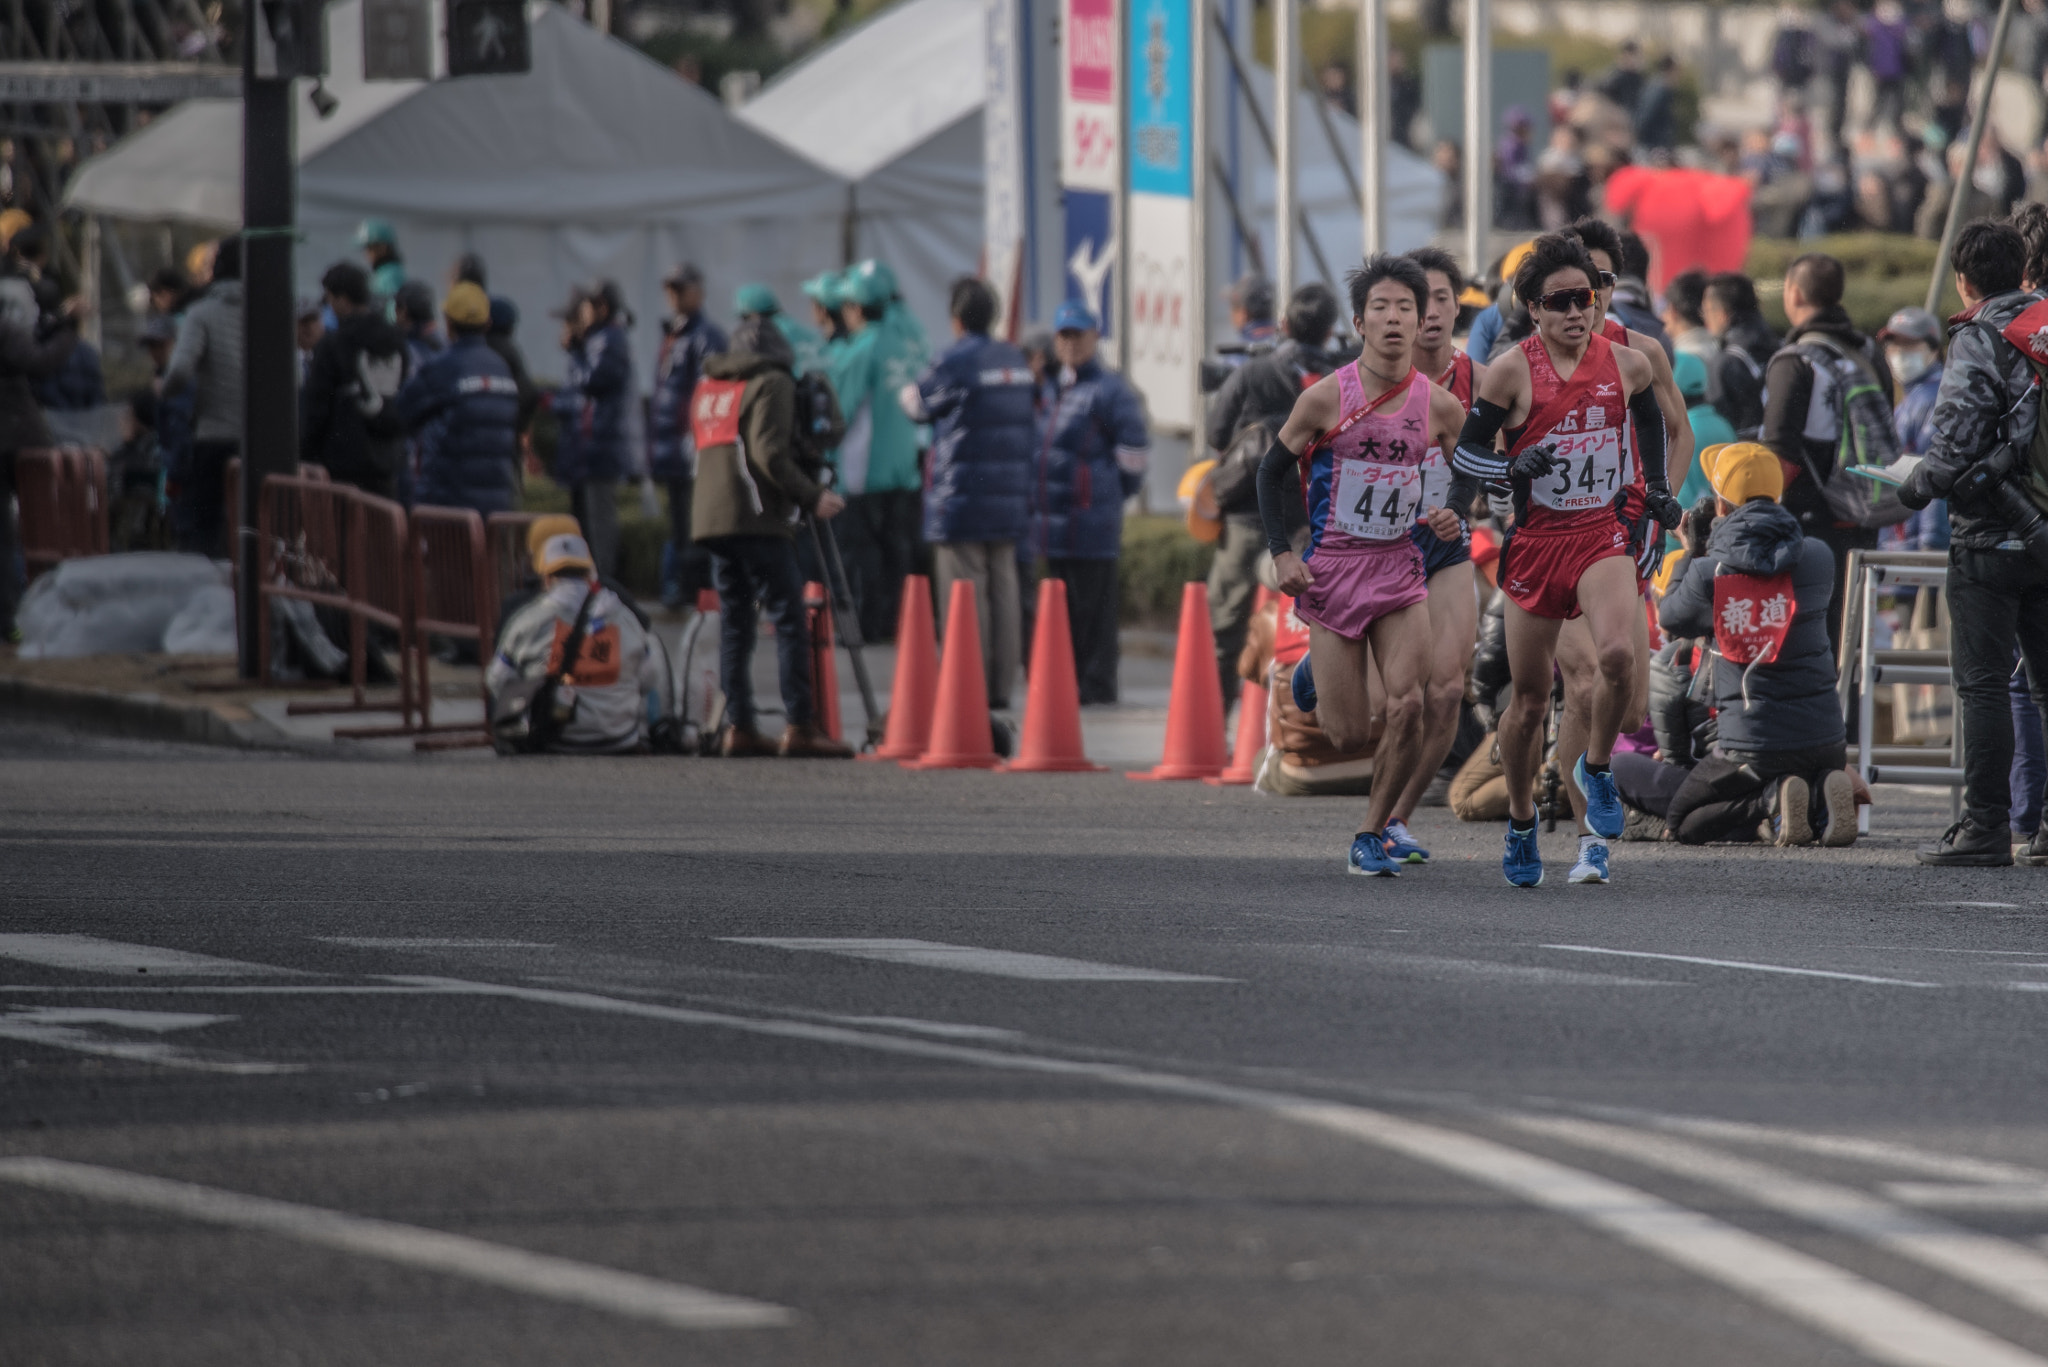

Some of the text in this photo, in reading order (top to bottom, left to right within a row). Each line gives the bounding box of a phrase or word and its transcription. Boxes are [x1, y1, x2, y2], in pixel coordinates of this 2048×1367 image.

[1556, 406, 1606, 432] 広島
[1359, 437, 1408, 461] 大分
[1556, 434, 1615, 456] ダイソー
[1345, 468, 1361, 478] The
[1552, 455, 1616, 495] 34-7
[1354, 485, 1415, 525] 44-7
[1565, 496, 1602, 507] FRESTA
[1721, 593, 1788, 634] 報道
